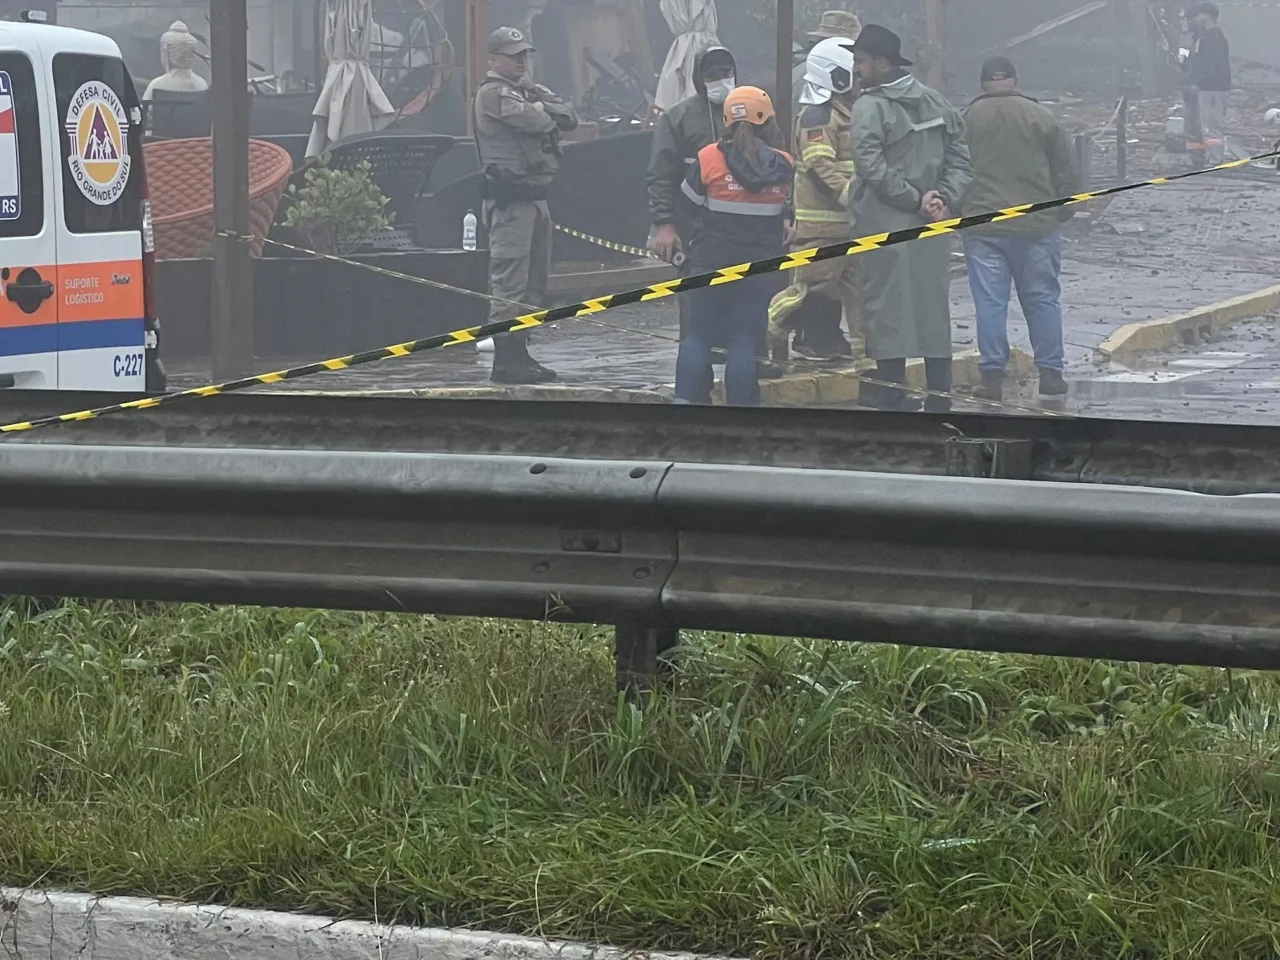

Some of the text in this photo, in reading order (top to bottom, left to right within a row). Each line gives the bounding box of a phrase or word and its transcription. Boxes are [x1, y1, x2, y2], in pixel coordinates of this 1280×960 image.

[72, 86, 121, 119] DEFESA CIVIL
[71, 160, 129, 201] RIO GRANDE DO SUL
[2, 199, 17, 213] RS
[65, 277, 99, 289] SUPORTE
[114, 354, 143, 377] C-227
